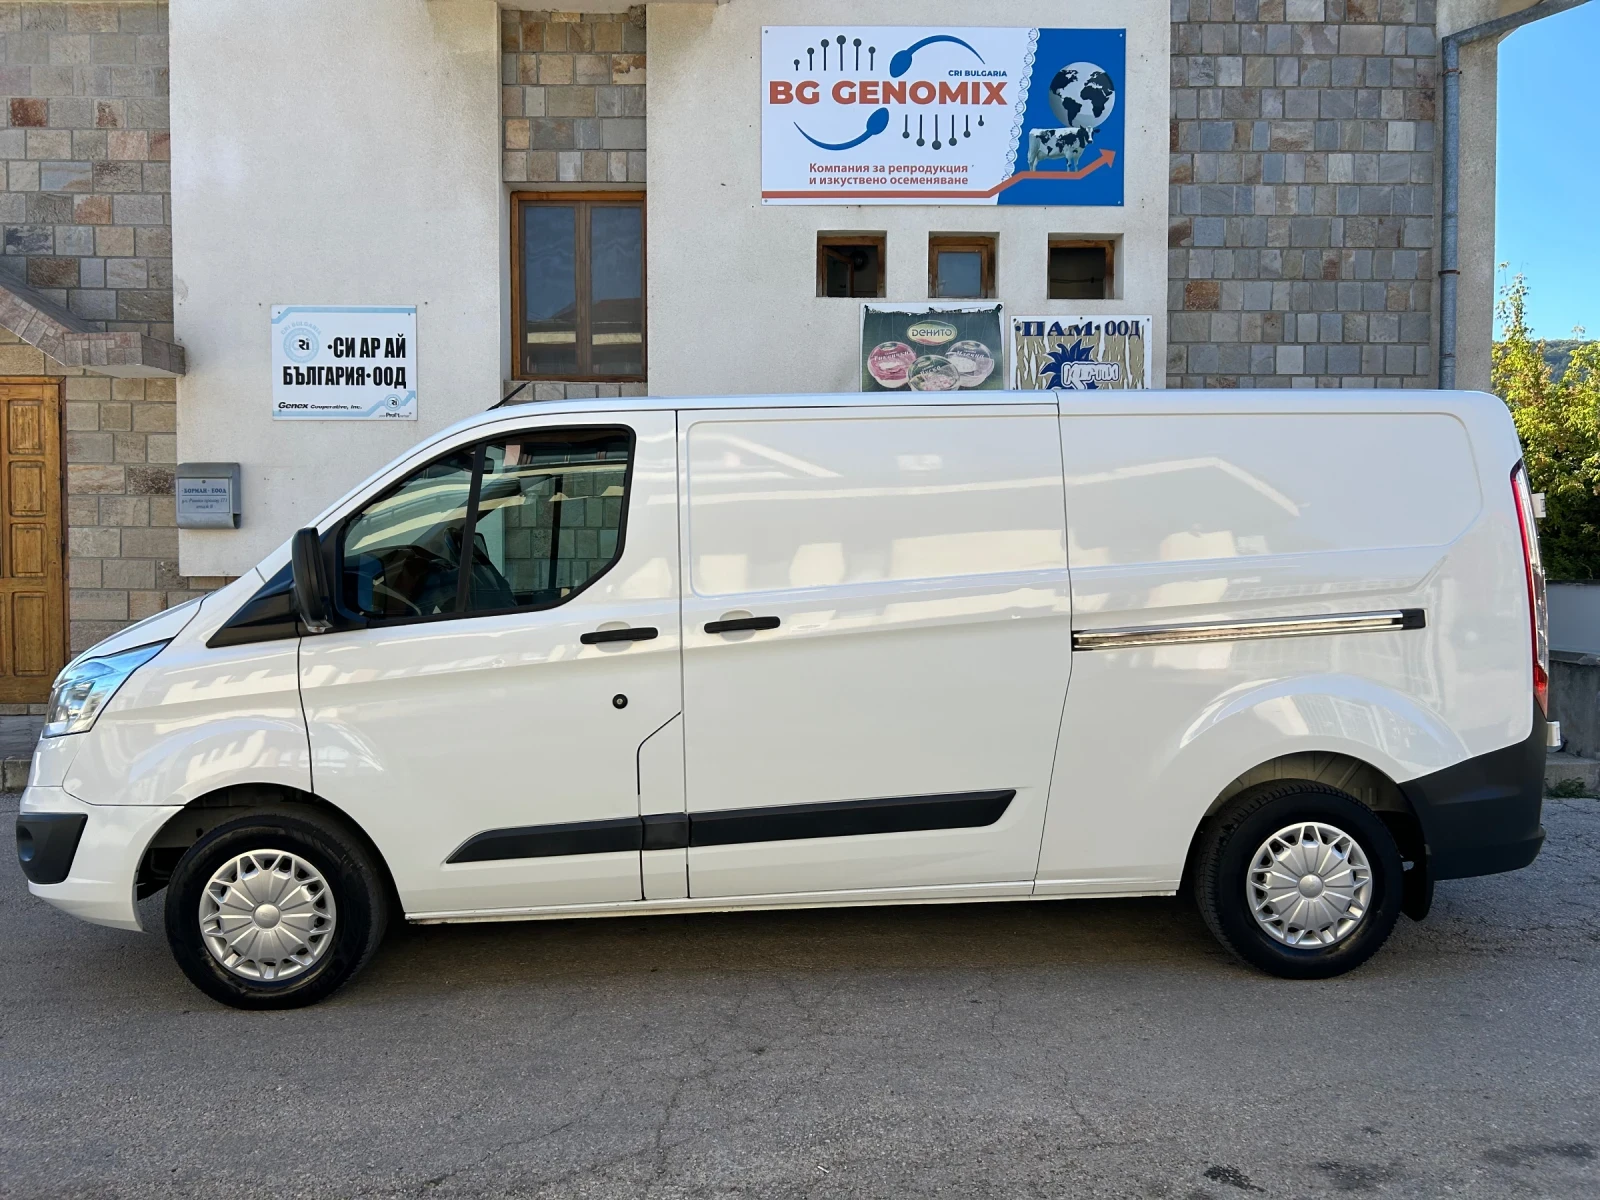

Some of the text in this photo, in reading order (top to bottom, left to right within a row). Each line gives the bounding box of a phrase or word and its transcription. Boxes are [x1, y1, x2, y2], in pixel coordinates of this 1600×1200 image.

[769, 80, 1008, 105] BG GENOMIX
[809, 163, 968, 175] Компания за репродукция
[809, 177, 968, 187] и изкуствено осеменяване
[1104, 320, 1141, 340] ООД
[278, 401, 309, 409] Genex
